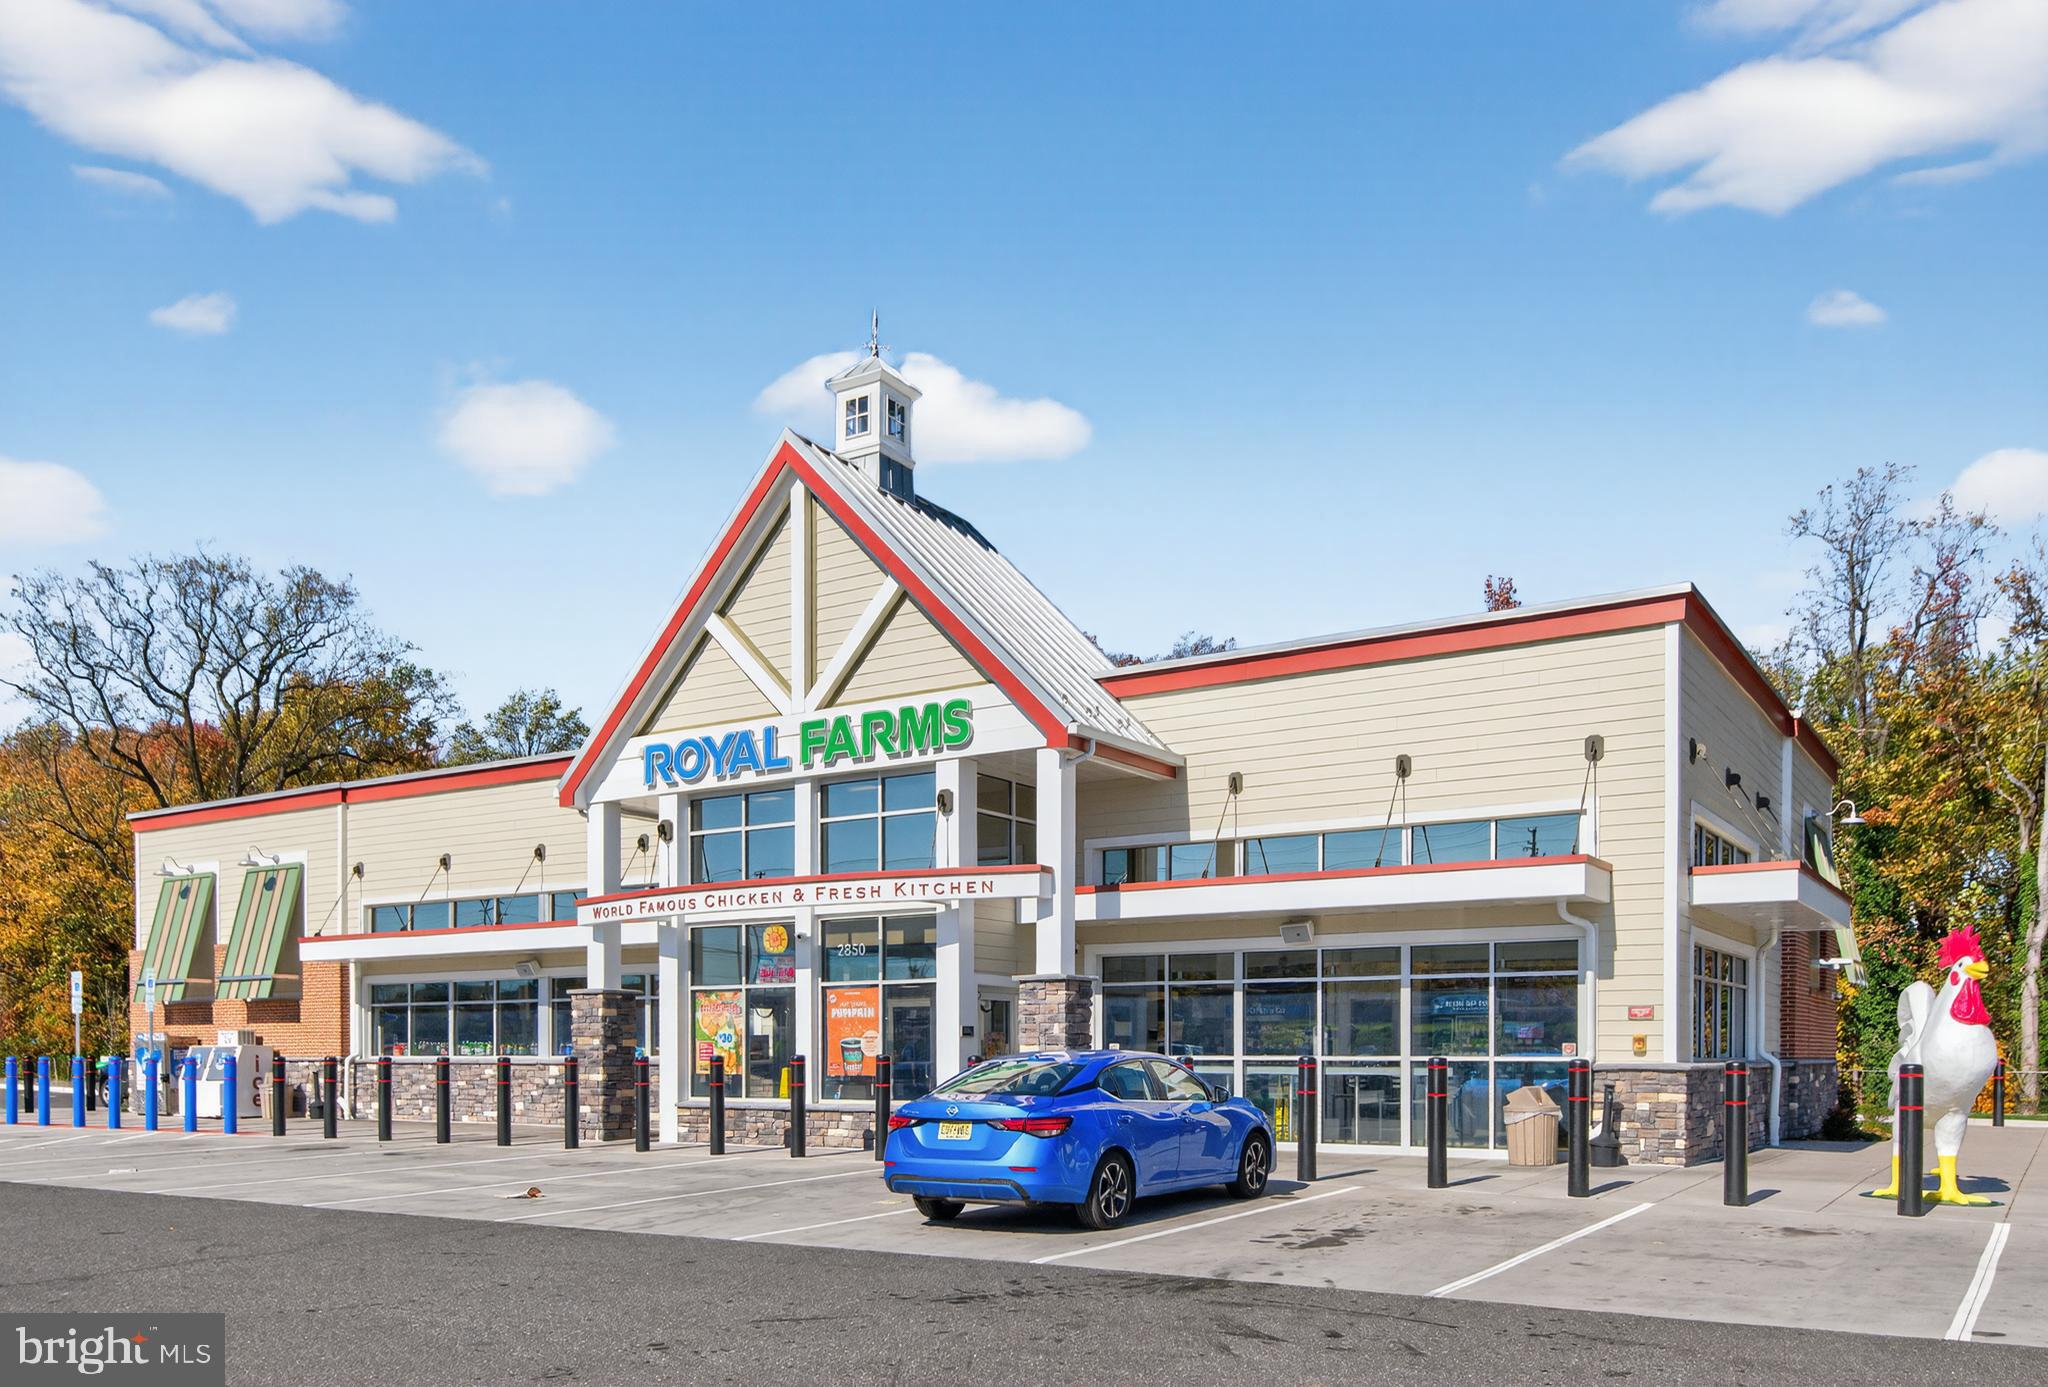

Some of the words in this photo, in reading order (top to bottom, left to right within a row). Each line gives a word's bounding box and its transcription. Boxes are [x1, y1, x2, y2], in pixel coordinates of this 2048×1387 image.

[643, 725, 791, 787] ROYAL
[800, 699, 973, 765] FARMS
[593, 904, 633, 920] WORLD
[639, 898, 697, 914] FAMOUS
[704, 891, 783, 908] CHICKEN
[793, 888, 805, 902] &
[816, 885, 881, 901] FRESH
[894, 880, 994, 897] KITCHEN
[837, 943, 866, 956] 2850
